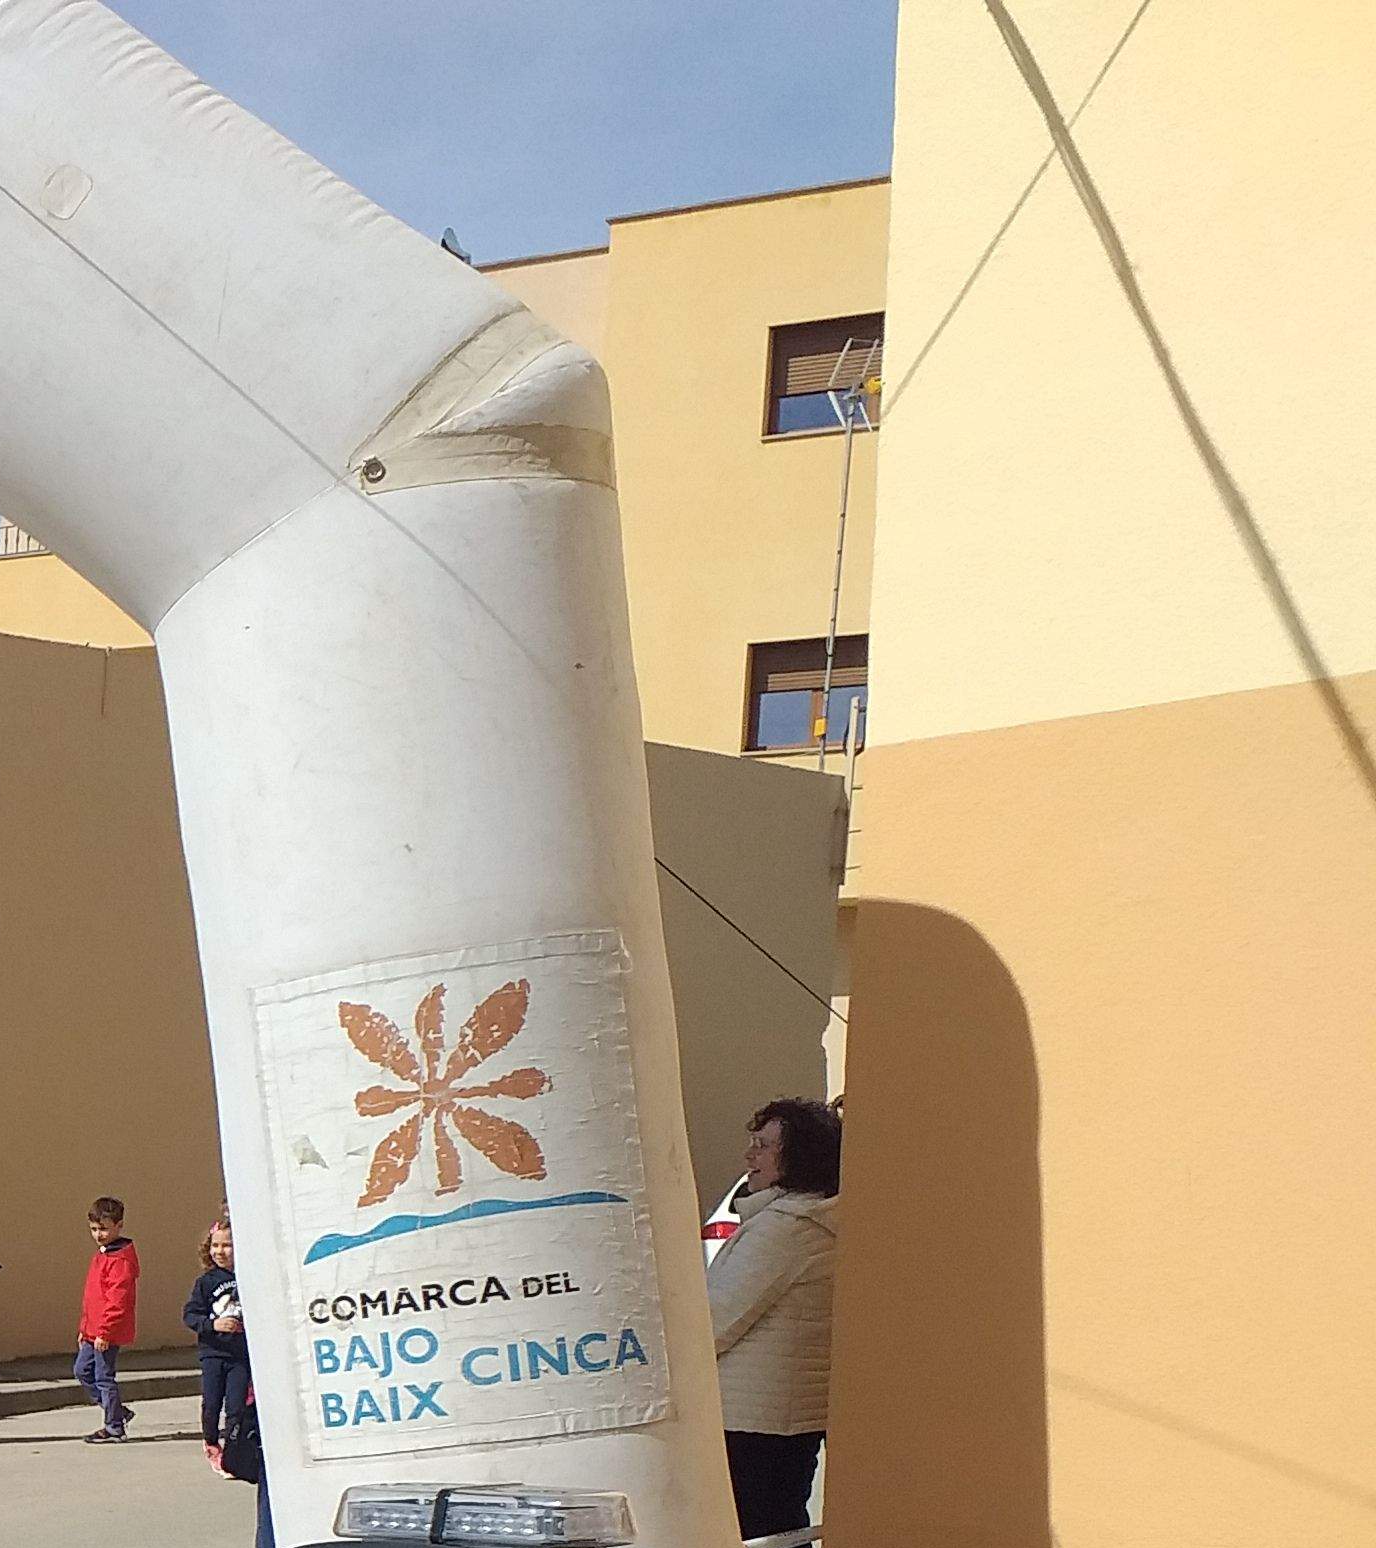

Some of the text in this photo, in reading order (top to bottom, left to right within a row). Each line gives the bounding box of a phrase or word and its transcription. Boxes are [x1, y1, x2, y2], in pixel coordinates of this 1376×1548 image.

[308, 1272, 580, 1326] COMARCA DEL
[313, 1327, 650, 1387] BAJO CINCA
[320, 1381, 450, 1429] BAIX
